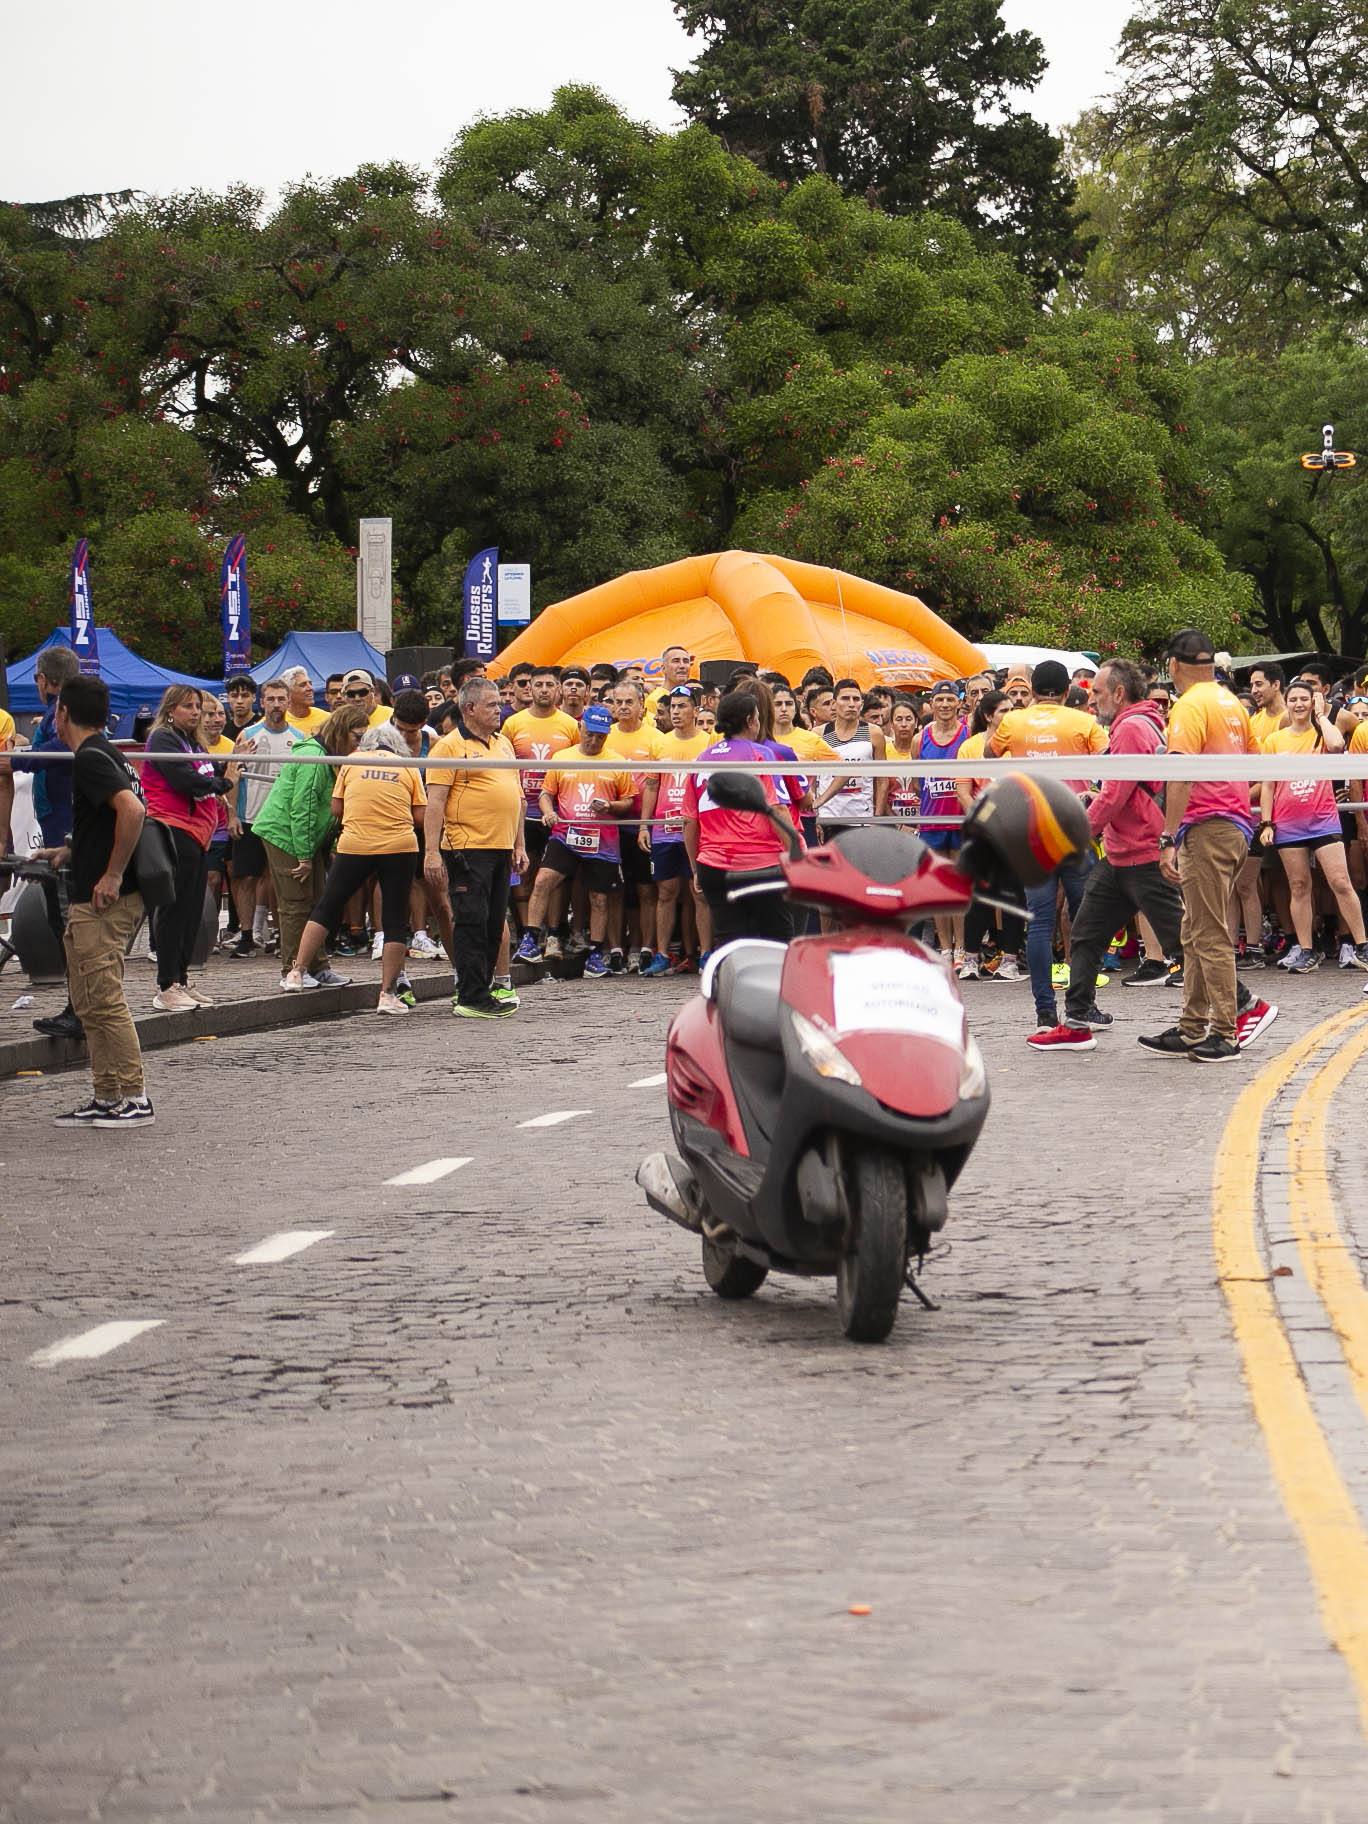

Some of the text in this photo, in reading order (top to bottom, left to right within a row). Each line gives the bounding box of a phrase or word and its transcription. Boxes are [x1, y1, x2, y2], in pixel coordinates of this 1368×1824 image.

[466, 585, 480, 641] Diosas
[477, 584, 492, 654] Runners
[361, 769, 400, 783] JUEZ
[527, 779, 543, 788] 57
[667, 788, 687, 797] COP
[899, 807, 917, 817] 169
[574, 836, 593, 846] 139
